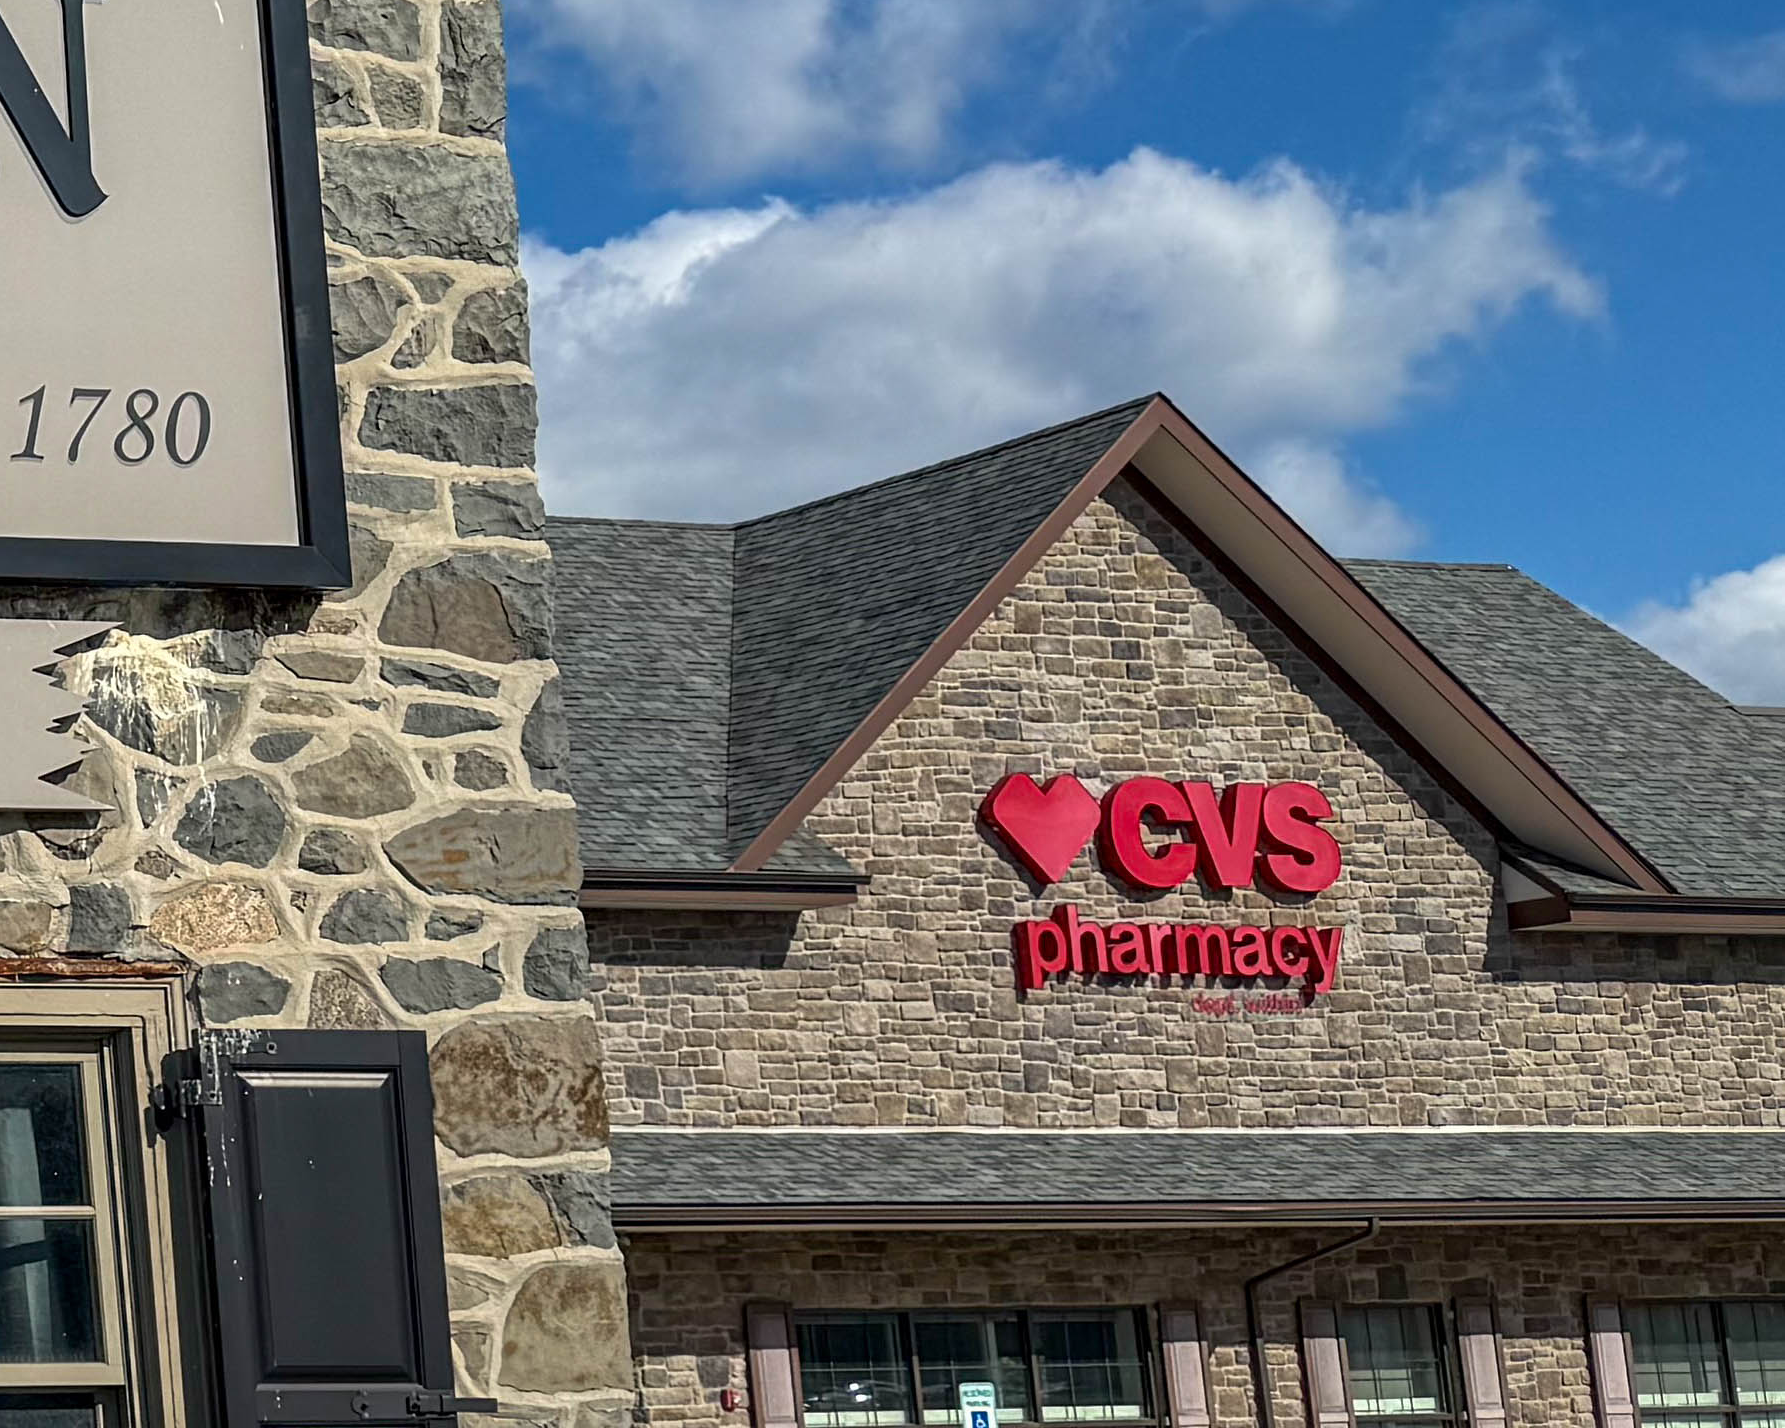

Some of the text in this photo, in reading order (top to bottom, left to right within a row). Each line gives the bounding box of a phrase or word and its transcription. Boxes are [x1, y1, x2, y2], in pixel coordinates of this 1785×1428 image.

[11, 386, 211, 468] 1780
[1098, 776, 1341, 892] CVS
[1015, 903, 1344, 994] pharmacy
